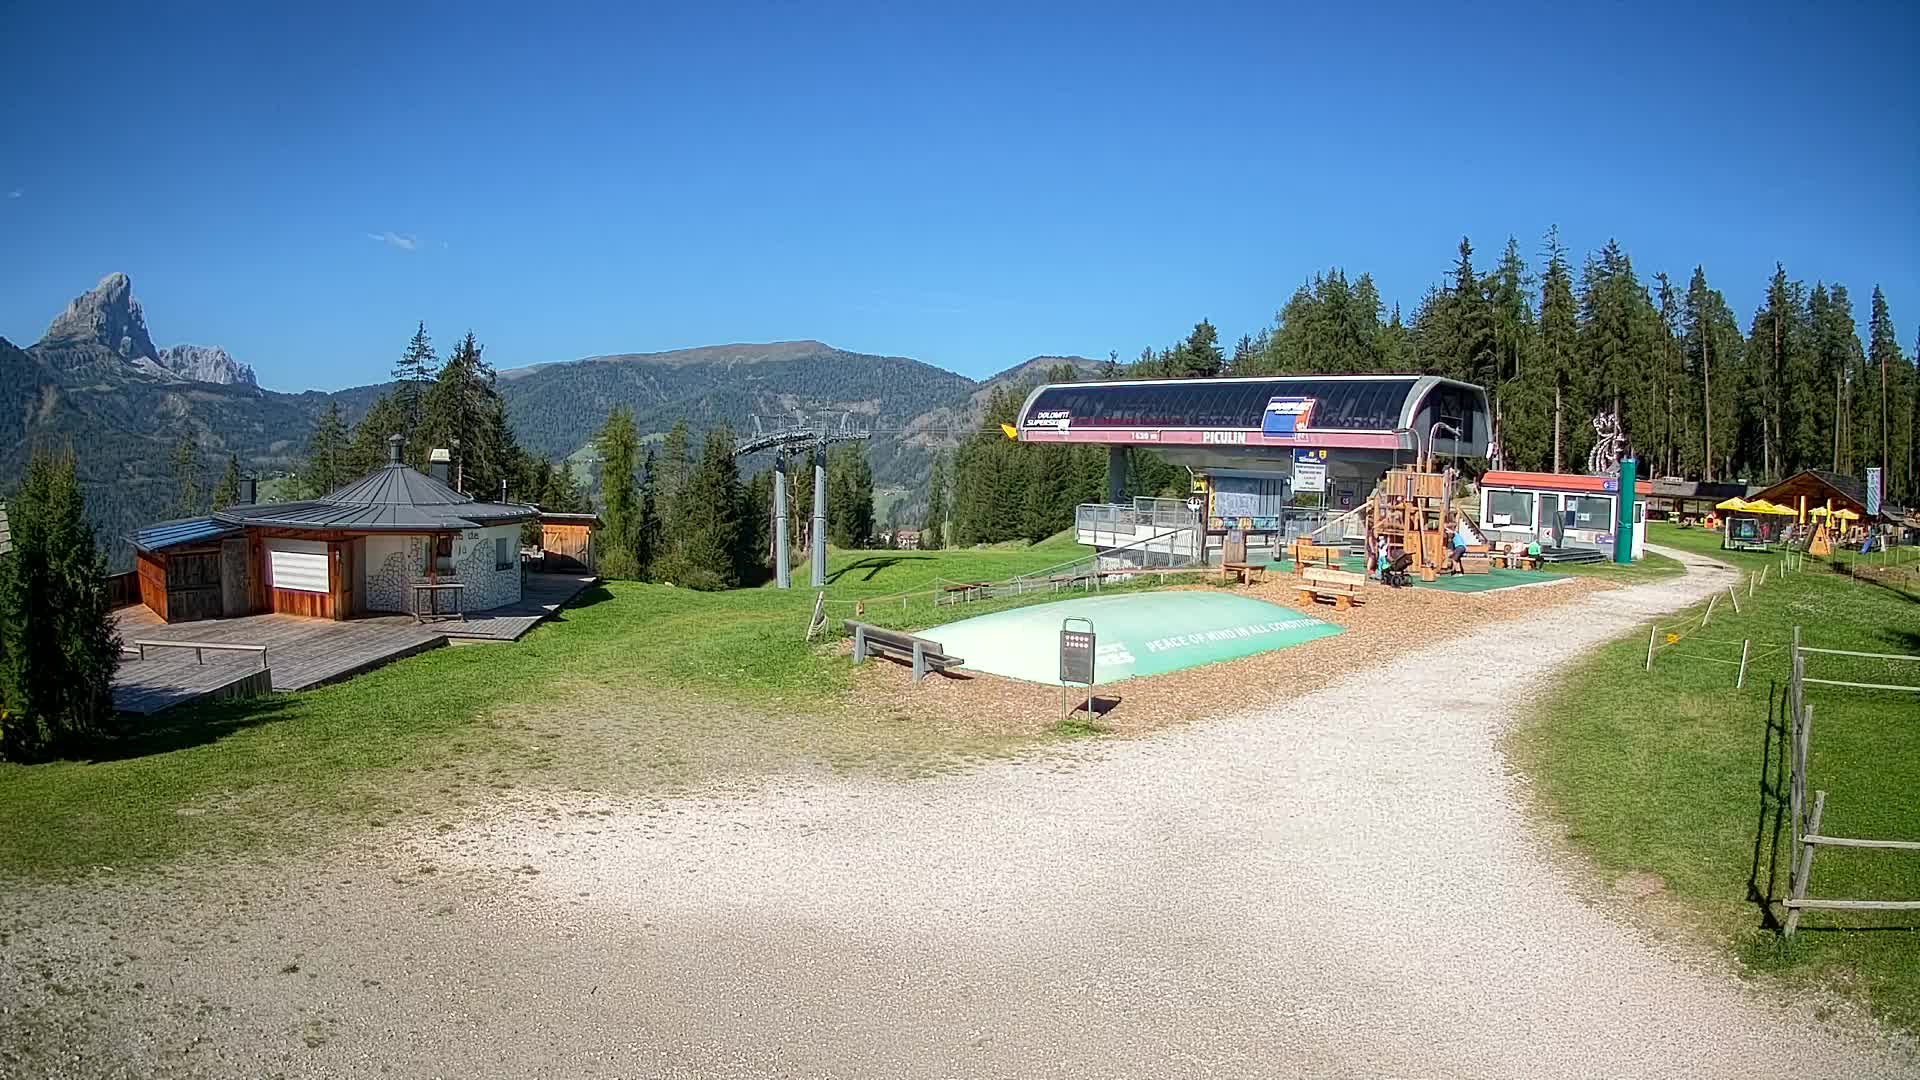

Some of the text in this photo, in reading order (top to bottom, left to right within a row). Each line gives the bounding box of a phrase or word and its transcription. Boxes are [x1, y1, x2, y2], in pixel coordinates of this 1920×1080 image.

[1202, 431, 1246, 444] PICULIN
[1144, 635, 1190, 653] PEACE
[1188, 633, 1205, 645] OF
[1206, 629, 1237, 641] MIND
[1233, 626, 1250, 638] IN
[1249, 624, 1270, 634] ALL
